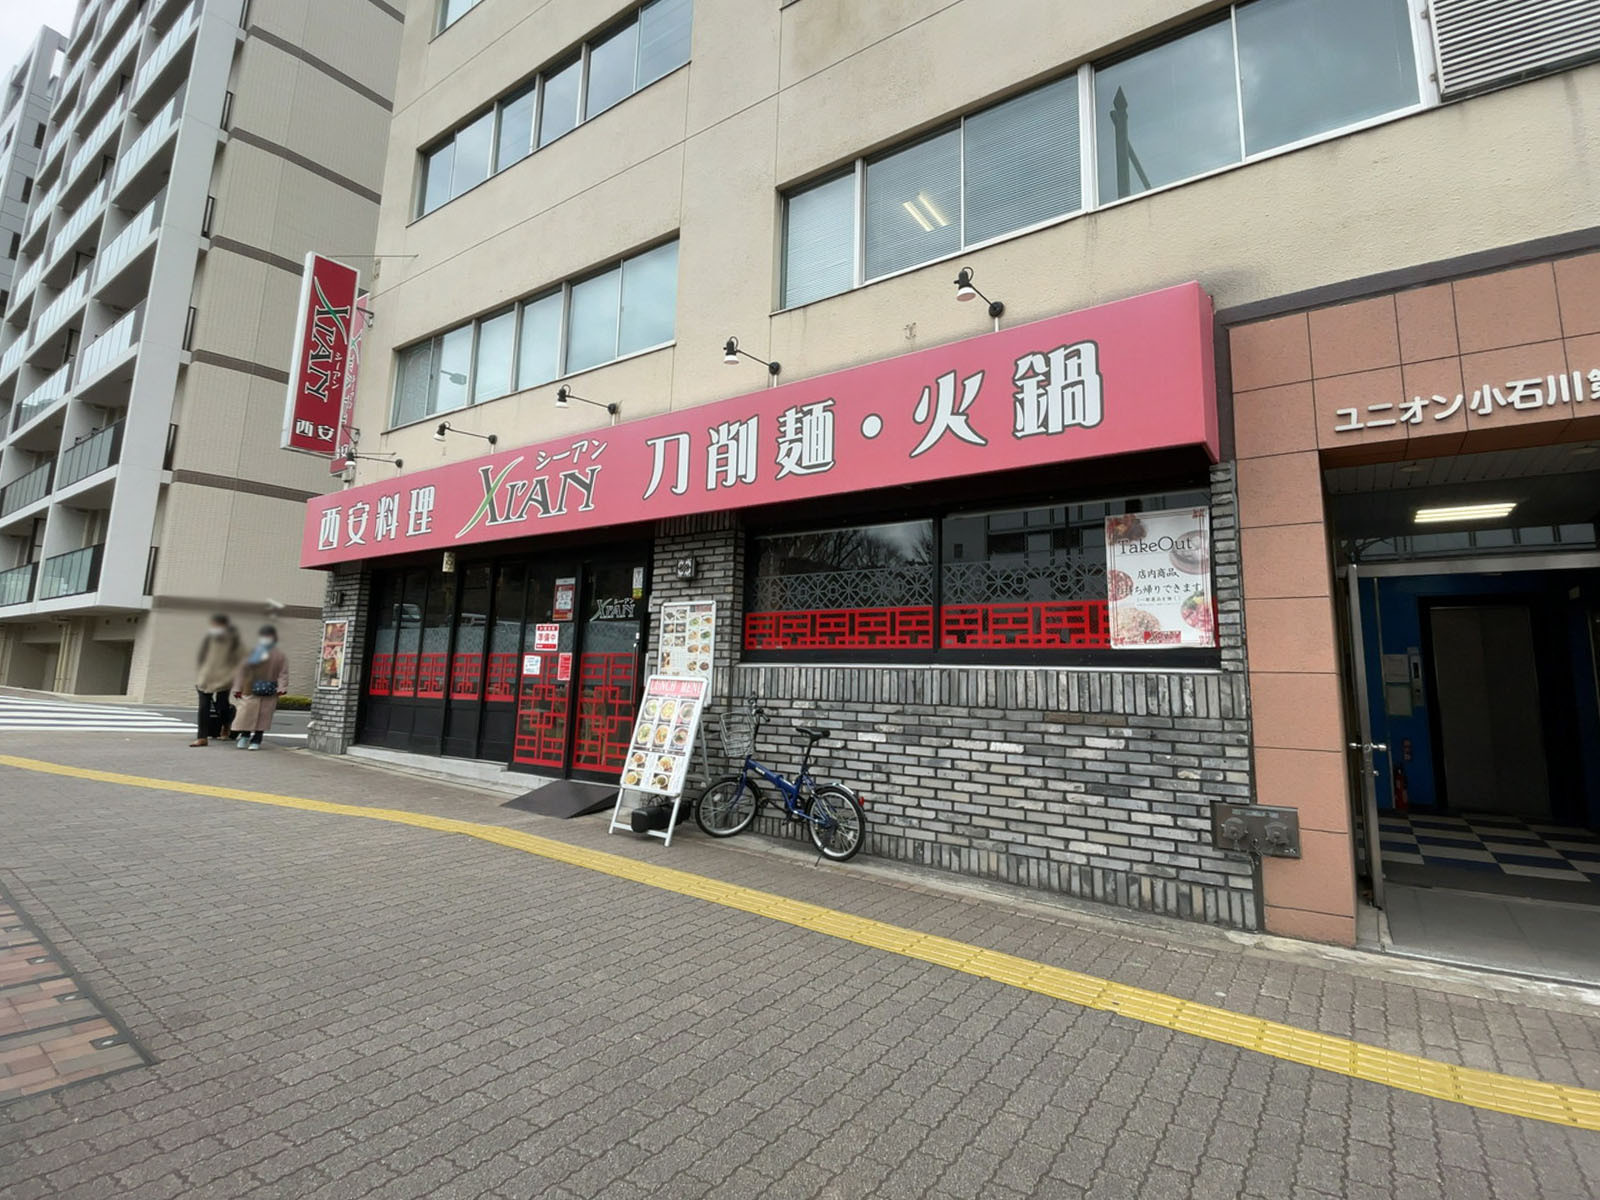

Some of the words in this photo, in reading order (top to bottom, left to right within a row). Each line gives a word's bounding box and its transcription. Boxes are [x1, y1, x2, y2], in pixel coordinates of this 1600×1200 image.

[295, 418, 335, 443] 西安
[535, 439, 608, 471] シーアン
[318, 486, 437, 551] 西安料理
